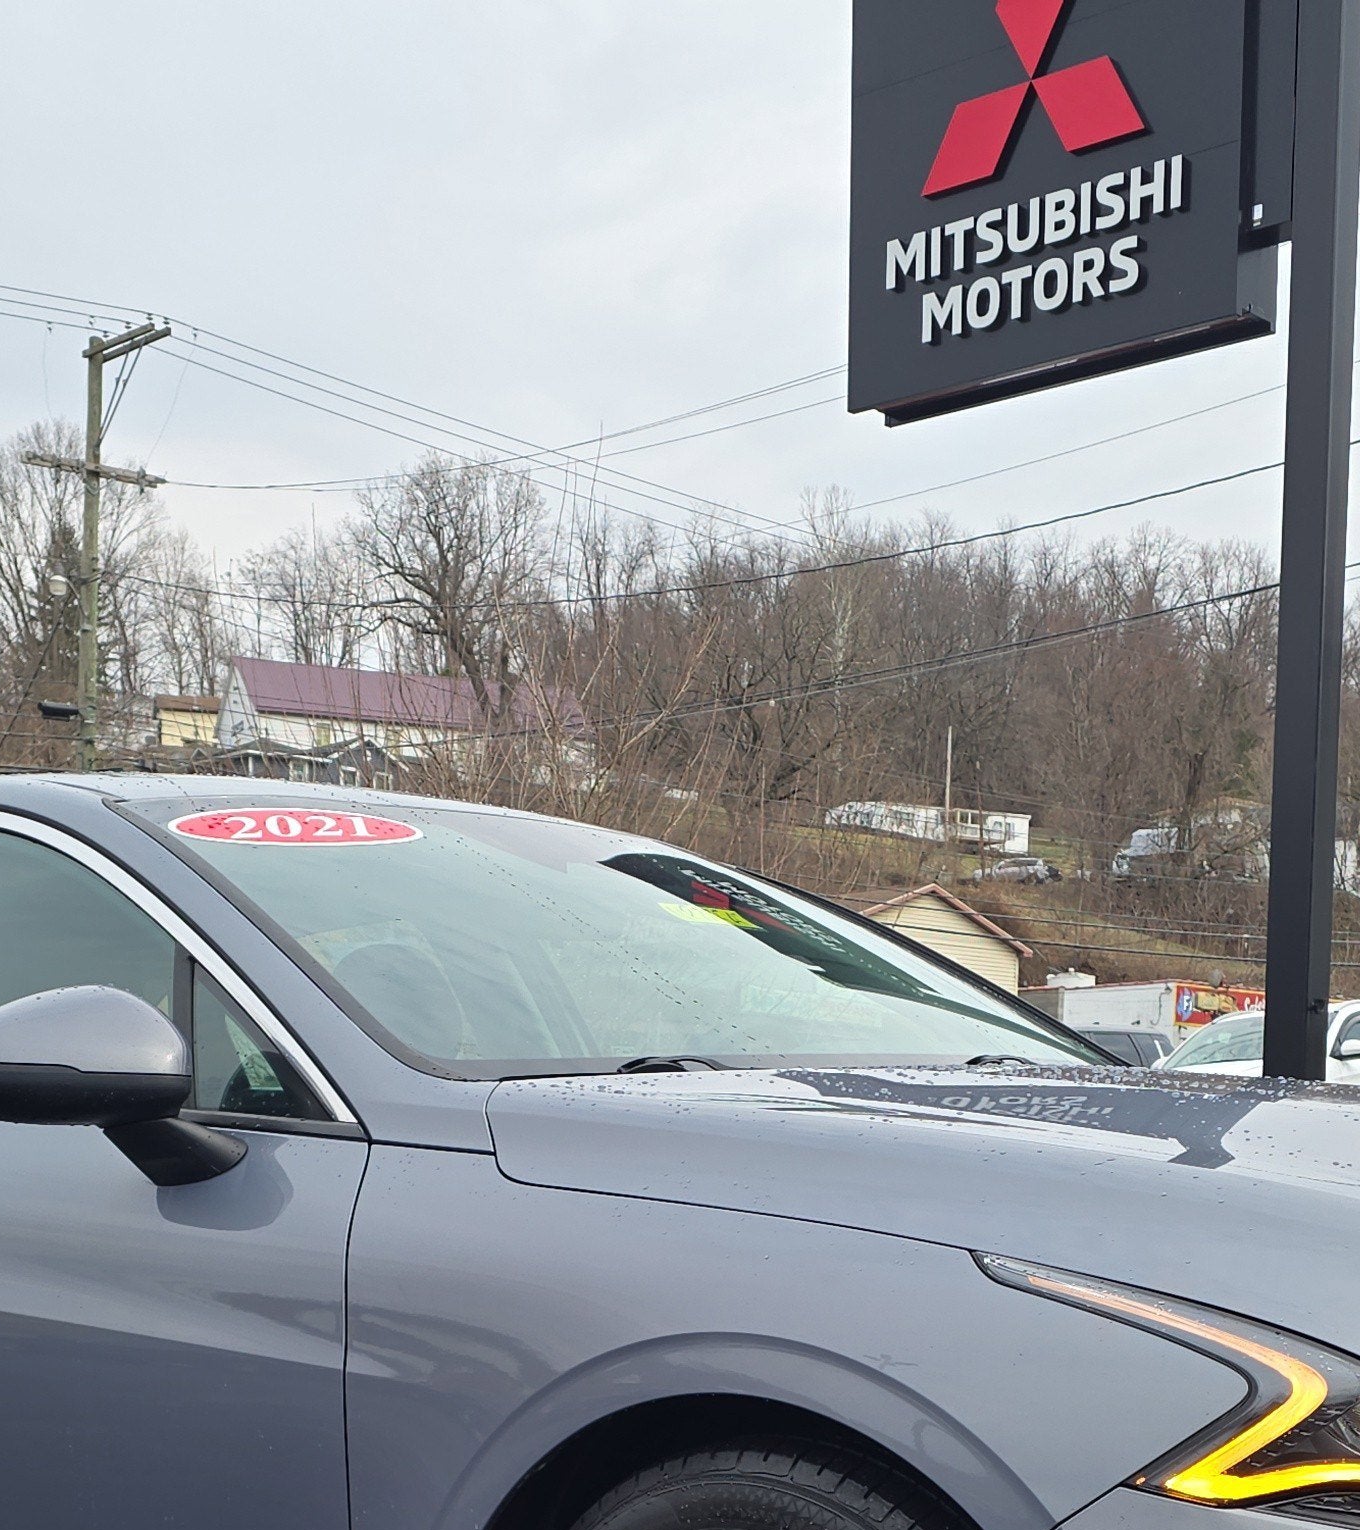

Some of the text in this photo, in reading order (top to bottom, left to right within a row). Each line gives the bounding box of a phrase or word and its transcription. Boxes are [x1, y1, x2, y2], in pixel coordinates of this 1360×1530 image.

[885, 154, 1183, 290] MITSUBISHI
[921, 236, 1140, 344] MOTORS
[223, 814, 378, 839] 2021
